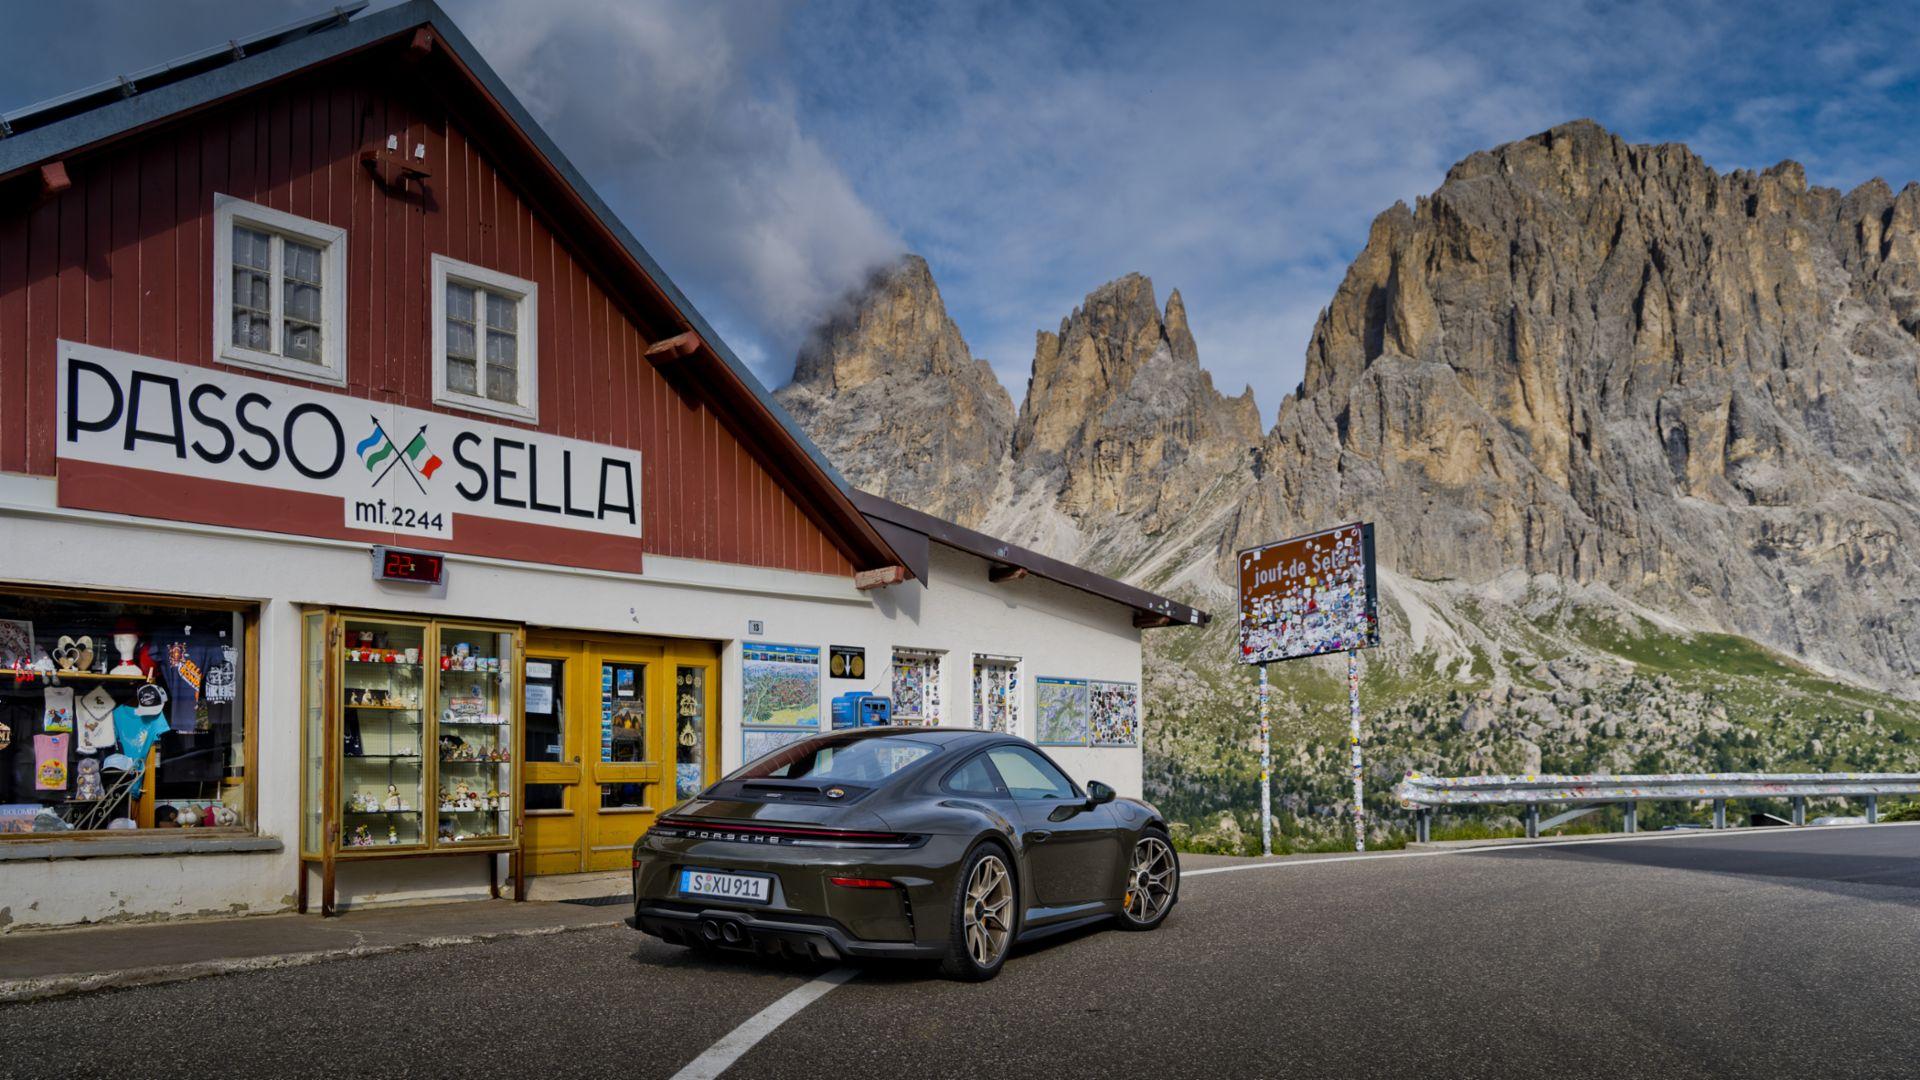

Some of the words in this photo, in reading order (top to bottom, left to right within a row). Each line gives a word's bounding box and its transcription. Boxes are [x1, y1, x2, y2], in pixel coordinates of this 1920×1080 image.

[66, 358, 346, 480] PASSO
[453, 431, 637, 525] SELLA
[752, 623, 760, 632] 13
[688, 830, 780, 843] PORSCHE
[734, 879, 760, 897] 911
